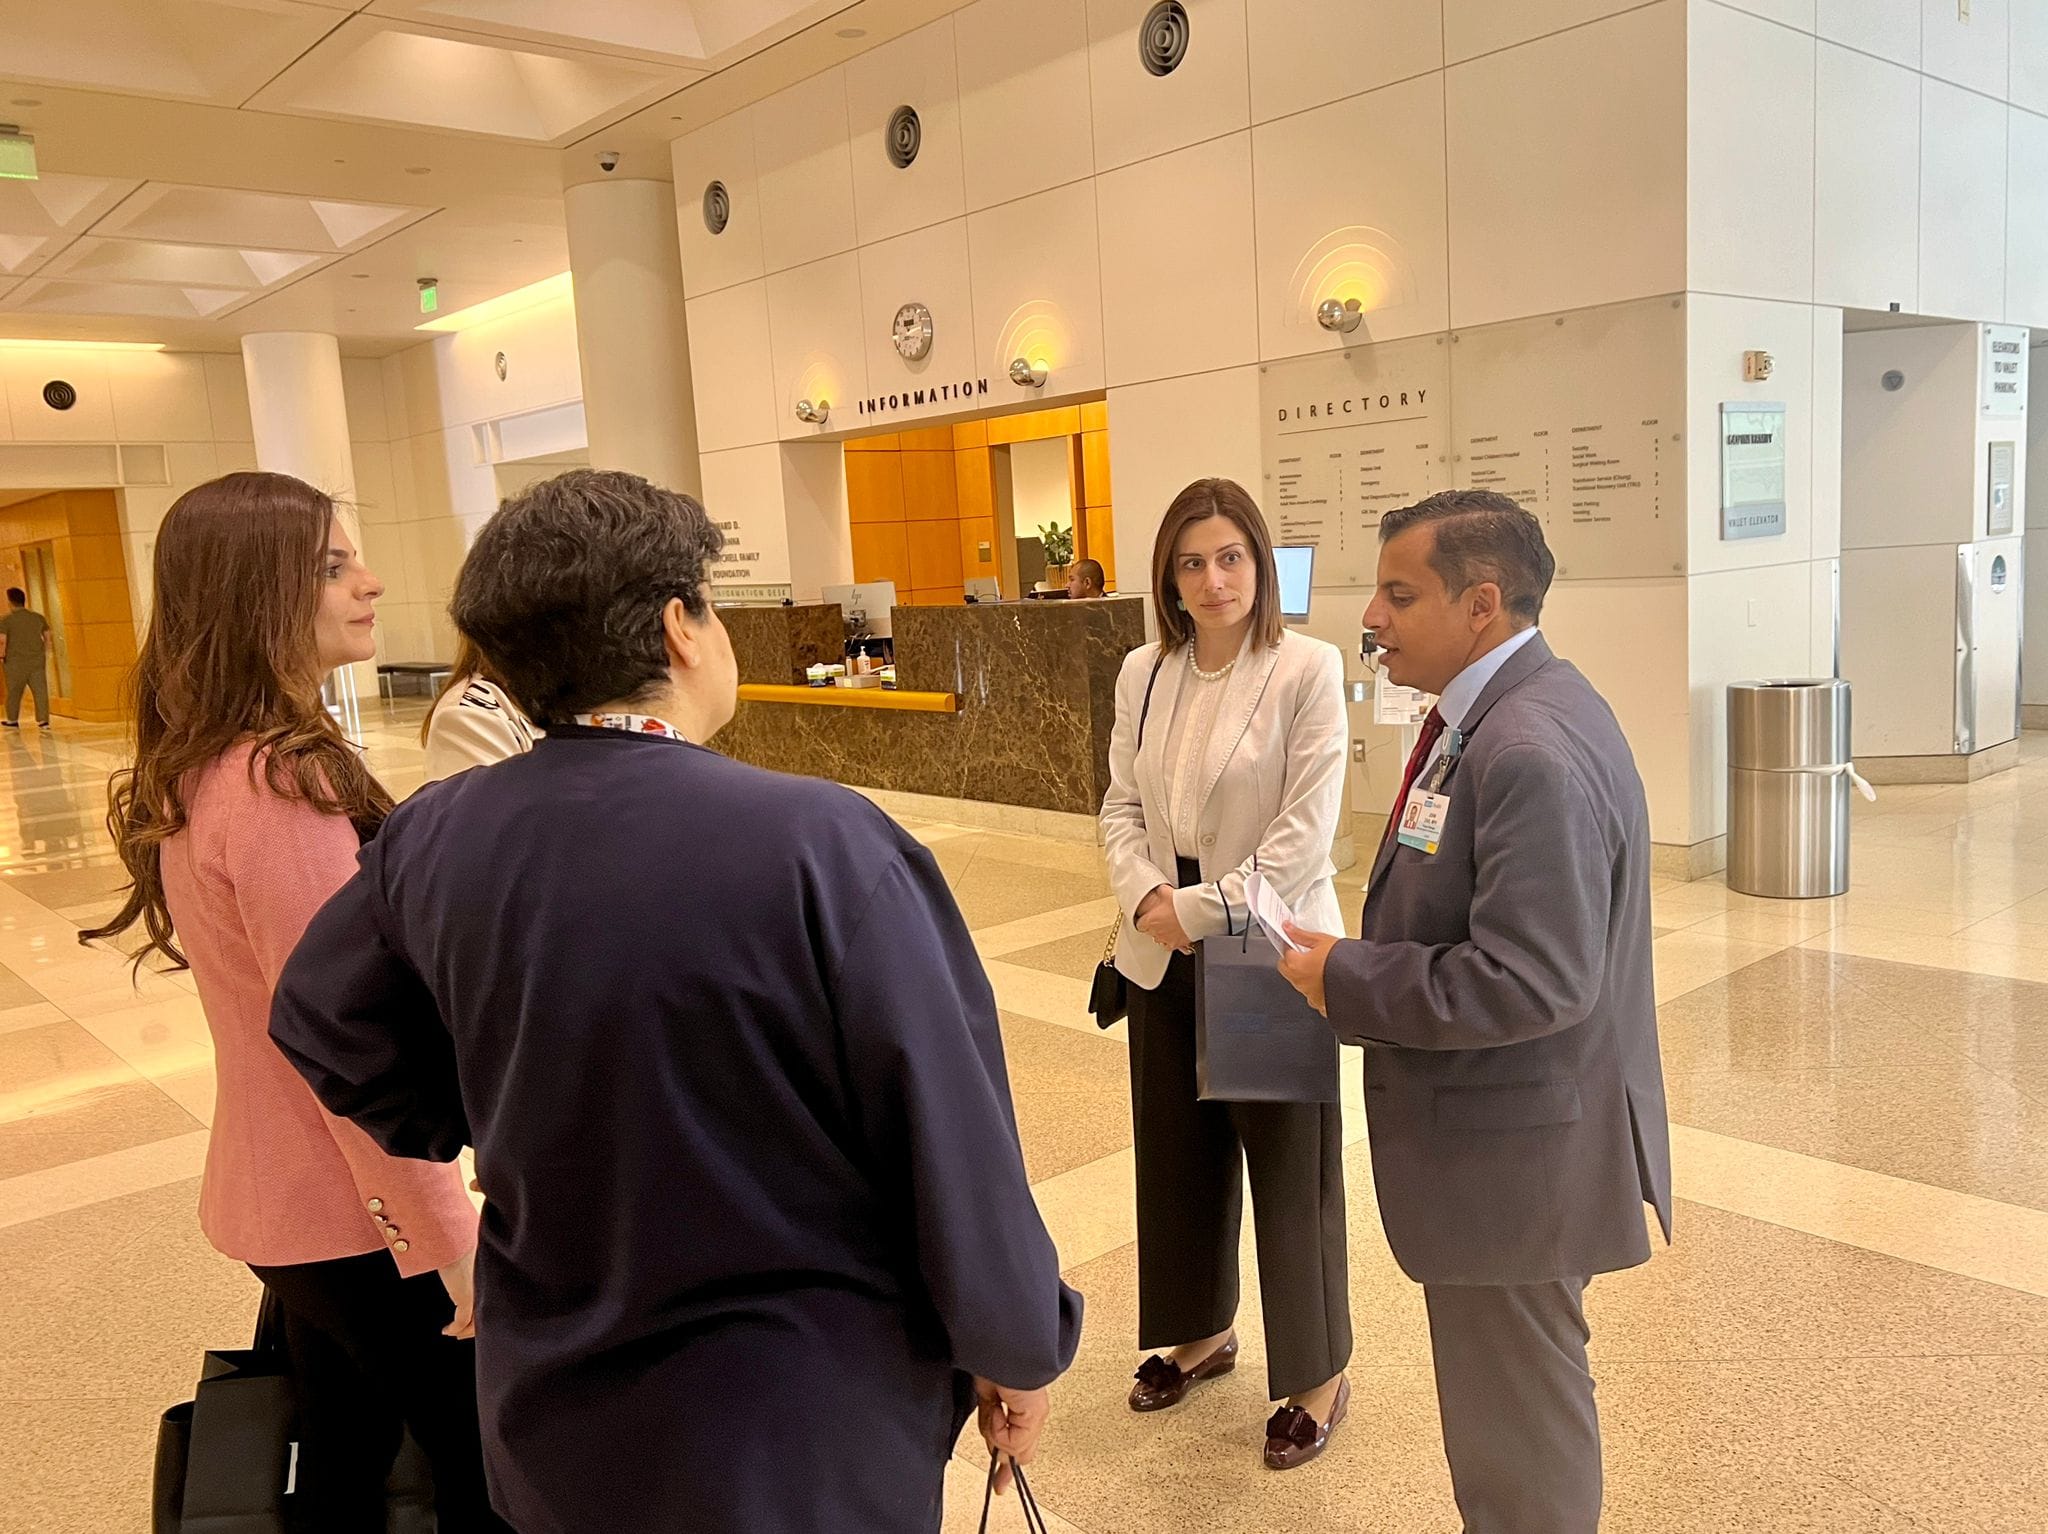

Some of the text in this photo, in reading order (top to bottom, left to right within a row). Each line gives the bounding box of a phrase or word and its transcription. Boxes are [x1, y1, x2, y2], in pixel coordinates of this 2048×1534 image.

[859, 378, 988, 414] INFORMATION
[1278, 389, 1426, 421] DIRECTORY
[1728, 514, 1779, 528] VALET ELEVATOR
[712, 569, 751, 579] FOUNDATION
[767, 588, 786, 597] DESK
